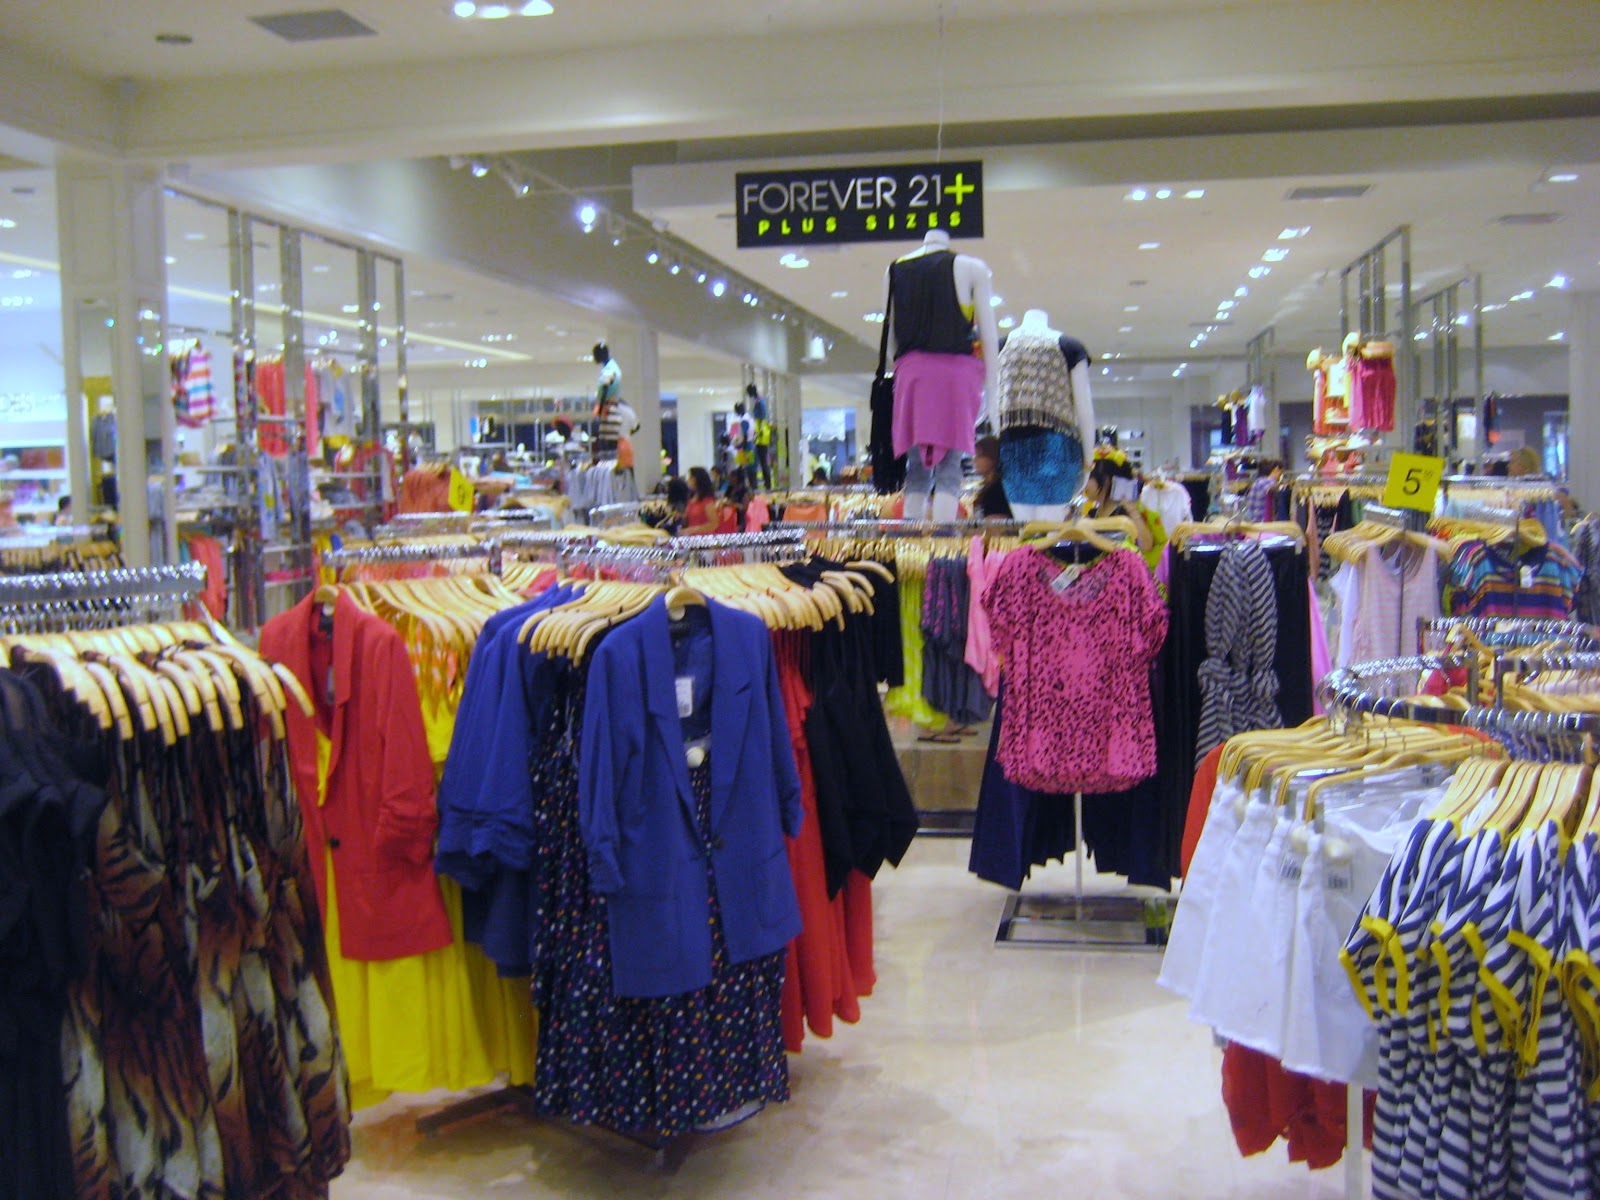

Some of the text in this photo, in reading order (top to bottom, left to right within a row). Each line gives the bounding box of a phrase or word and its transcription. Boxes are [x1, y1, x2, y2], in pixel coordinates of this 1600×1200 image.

[743, 176, 897, 215] FOREVER
[758, 211, 961, 236] PLUS SIZES
